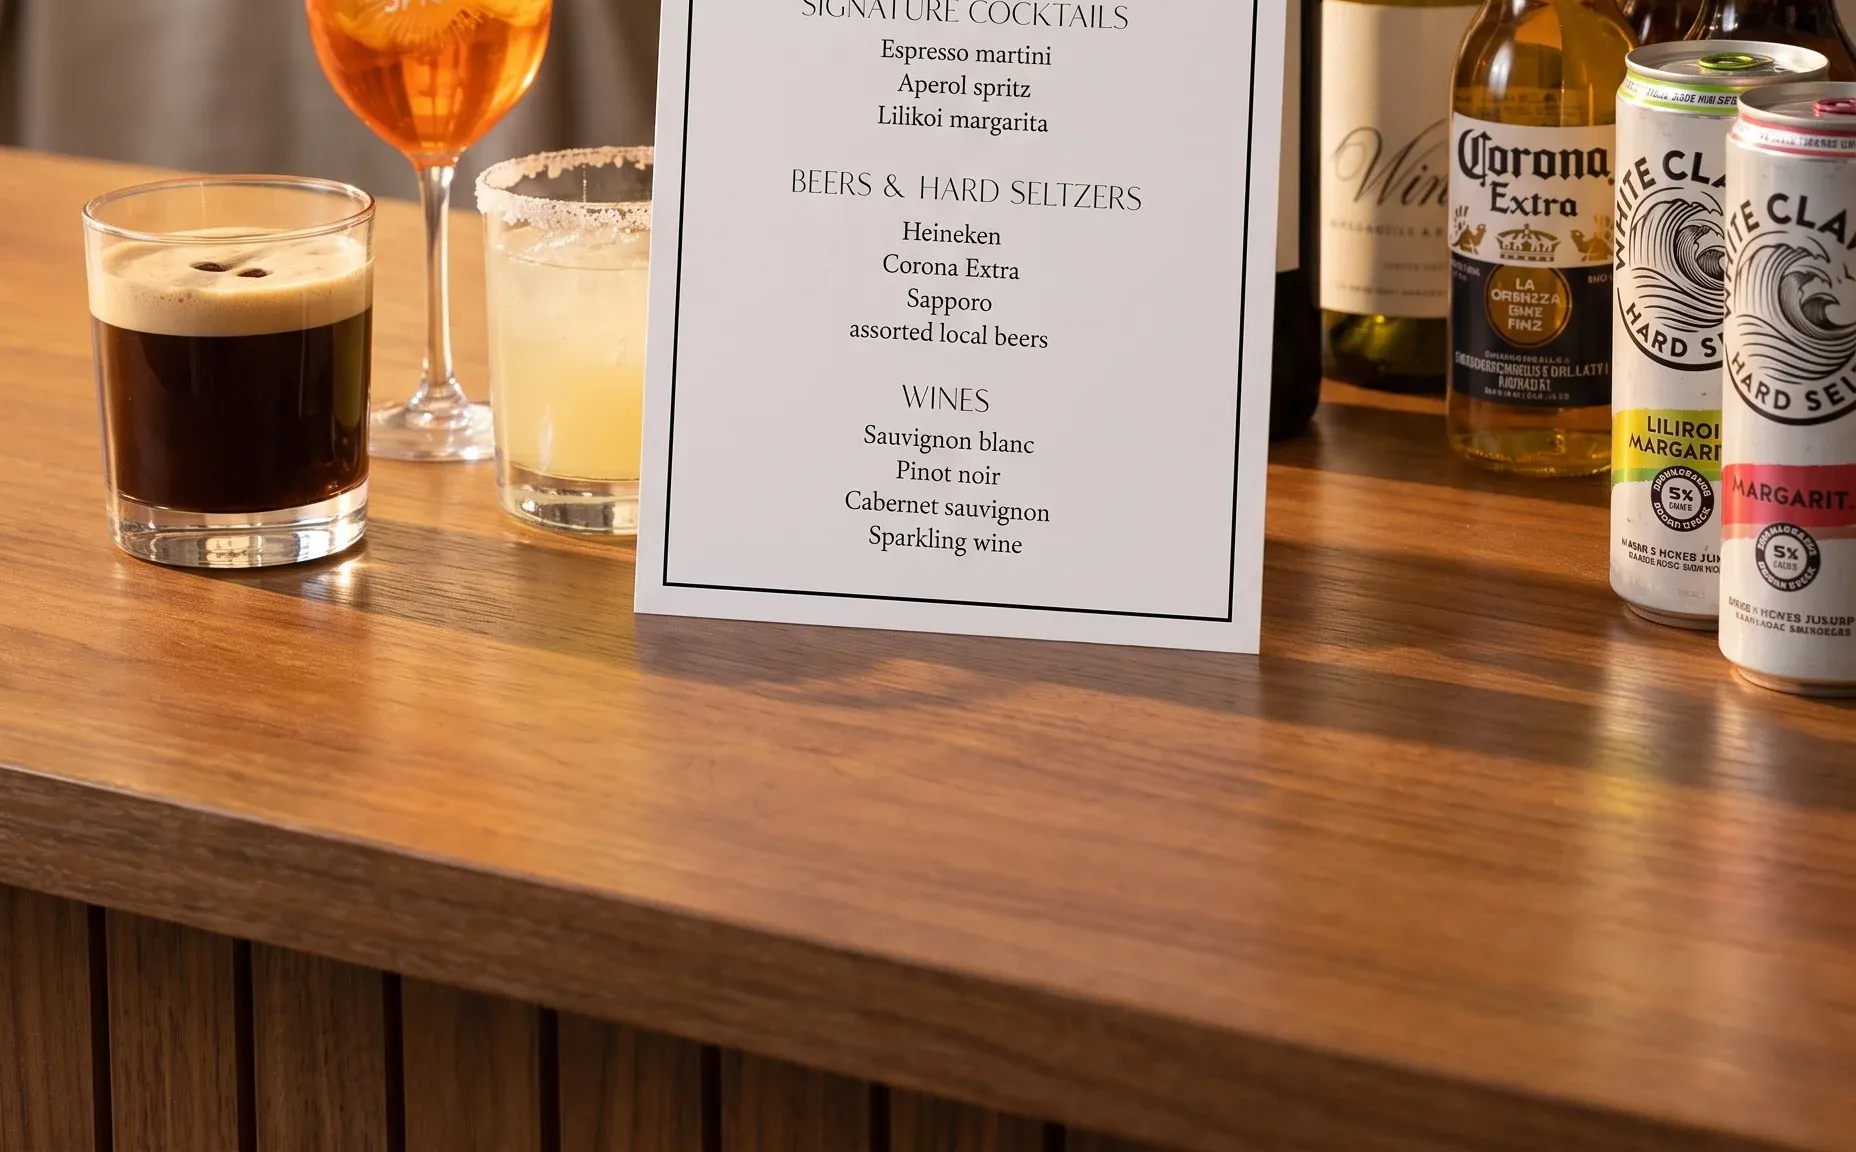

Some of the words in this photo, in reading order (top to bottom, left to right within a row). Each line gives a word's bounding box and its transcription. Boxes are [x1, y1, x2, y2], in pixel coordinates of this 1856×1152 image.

[968, 0, 1129, 30] COCKTAILS
[879, 38, 970, 66] Espresso
[974, 44, 1052, 66] martini
[896, 72, 967, 100] Aperol
[973, 77, 1032, 103] spritz
[876, 104, 943, 128] Lilikoi
[948, 111, 1049, 137] margarita
[791, 168, 872, 197] BEERS
[883, 173, 906, 199] &
[920, 175, 1000, 203] HARD
[1010, 179, 1142, 210] SELTZERS
[1489, 180, 1578, 217] Extra
[1615, 156, 1656, 271] WHITE
[901, 220, 1002, 246] Heineken
[882, 253, 960, 277] Corona
[964, 257, 1021, 281] Extra
[906, 287, 993, 317] Sapporo
[849, 321, 934, 342] assorted
[938, 321, 988, 346] local
[993, 324, 1049, 349] beers
[1626, 302, 1688, 358] HARD
[1731, 351, 1791, 410] HARD
[901, 384, 990, 413] WINES
[863, 424, 973, 455] Sauvignon
[978, 429, 1035, 455] blanc
[895, 459, 953, 483] Pinot
[957, 465, 1002, 486] noir
[844, 489, 940, 516] Cabernet
[944, 499, 1051, 525] sauvignon
[1732, 475, 1855, 511] MARGARIT
[868, 524, 968, 558] Sparkling
[972, 532, 1023, 555] wine
